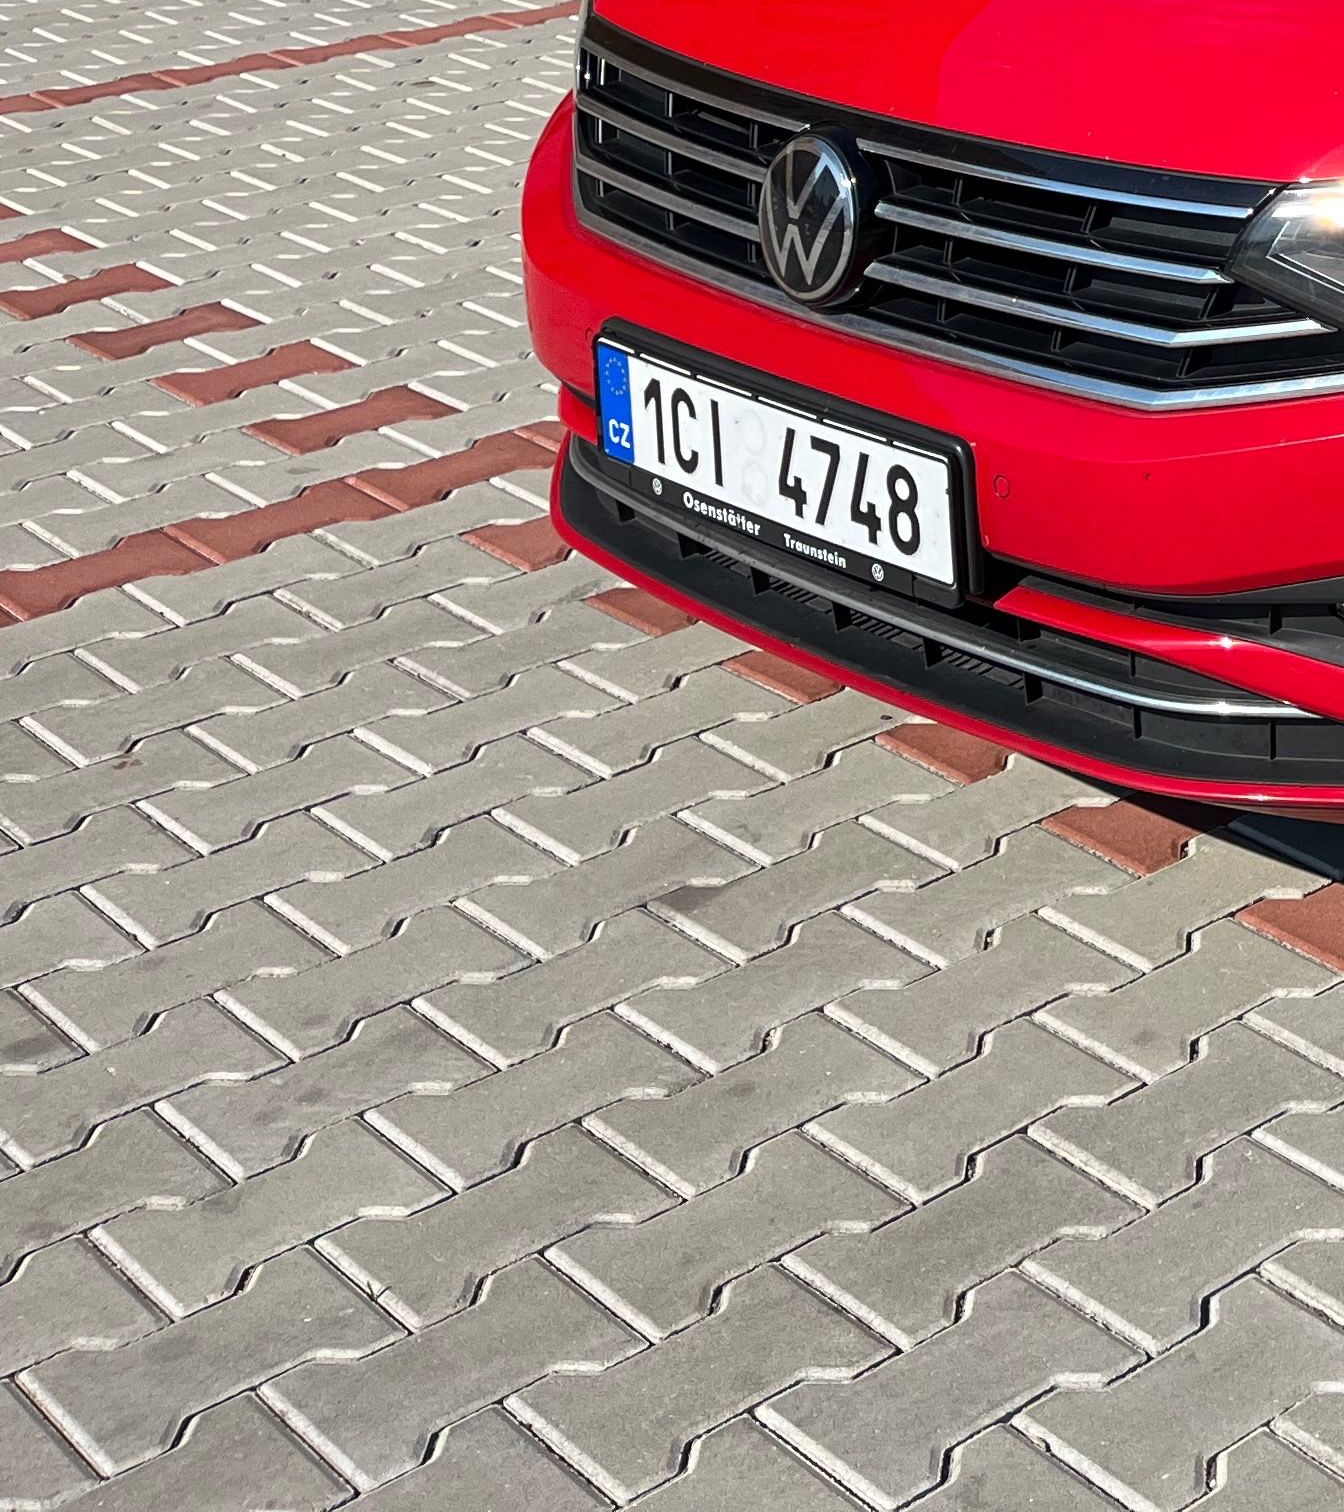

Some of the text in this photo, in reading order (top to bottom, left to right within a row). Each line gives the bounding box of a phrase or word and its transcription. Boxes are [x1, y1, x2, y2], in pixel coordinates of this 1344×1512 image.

[608, 418, 631, 449] CZ
[643, 377, 922, 557] 1CI 4748
[783, 532, 848, 569] Traunstein
